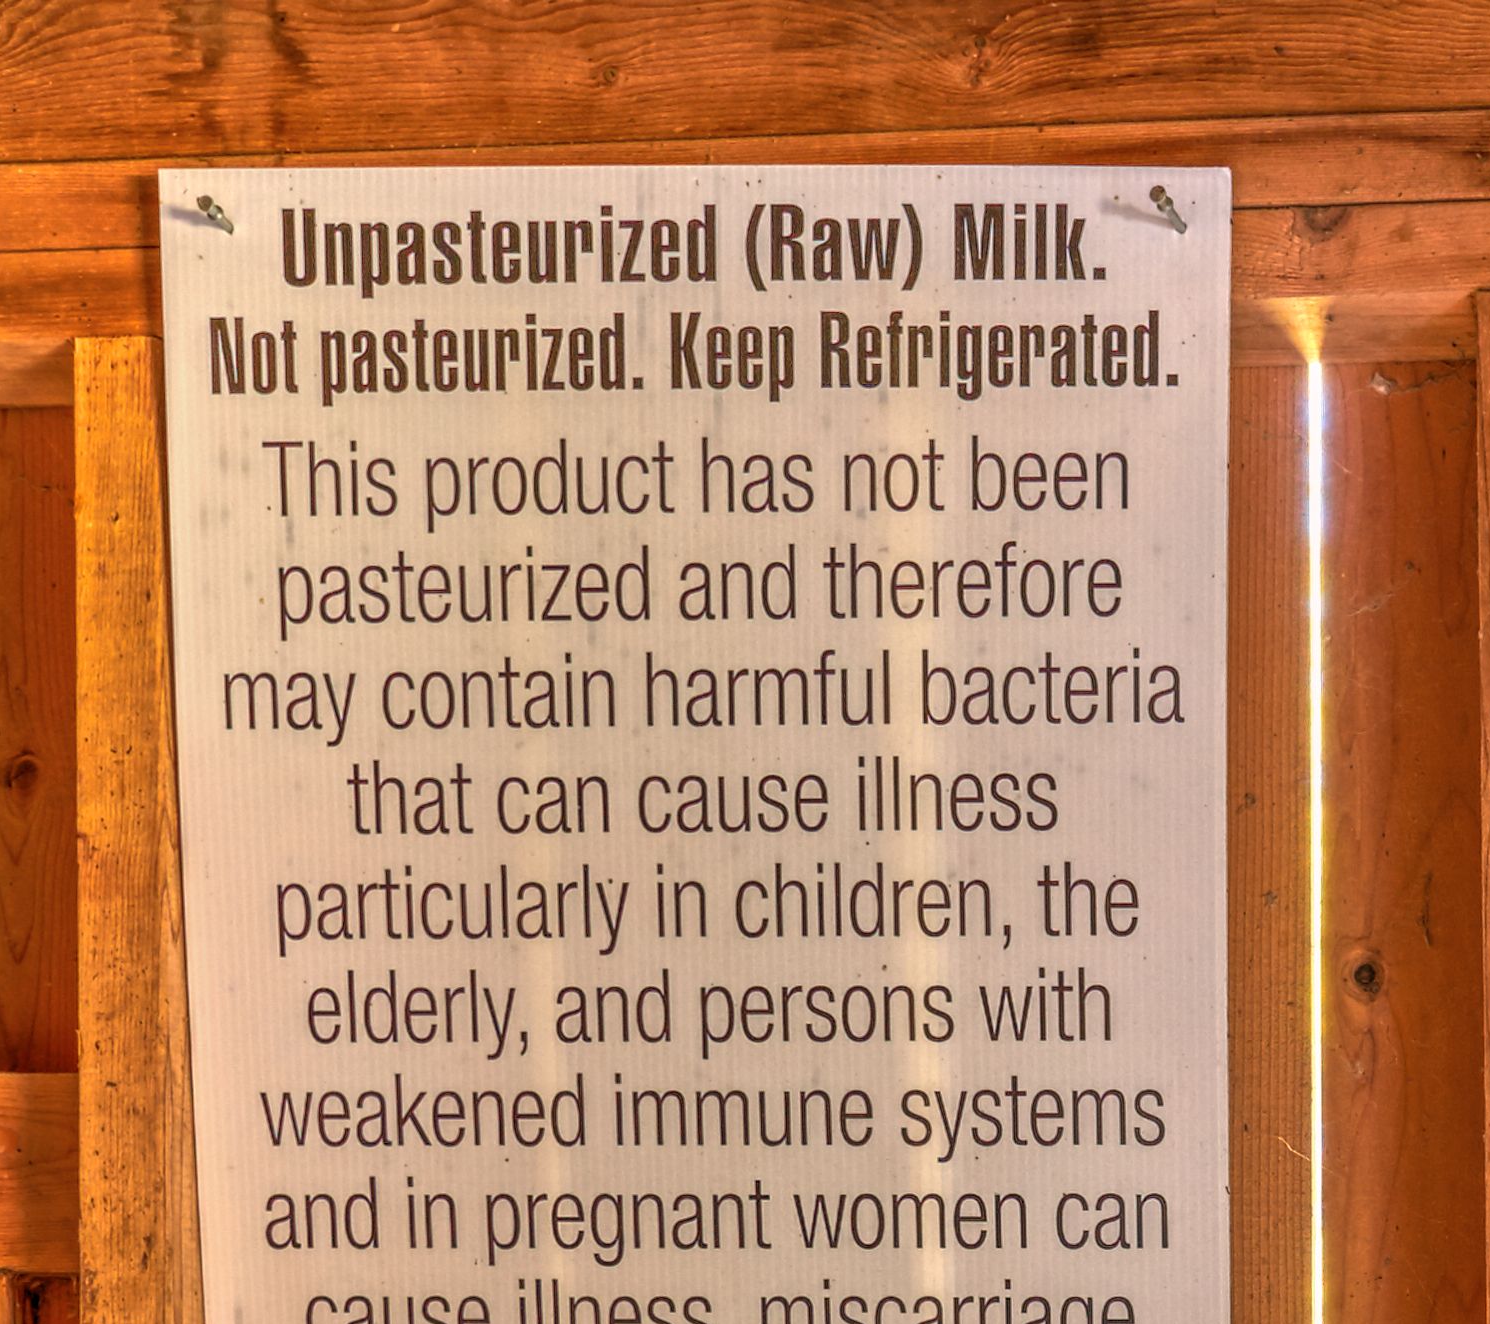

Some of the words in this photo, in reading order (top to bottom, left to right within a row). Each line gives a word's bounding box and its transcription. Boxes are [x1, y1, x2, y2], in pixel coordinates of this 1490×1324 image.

[281, 204, 718, 298] Unpasteurized
[746, 204, 924, 292] (Raw)
[952, 204, 1108, 282] Milk.
[209, 316, 301, 395] Not
[322, 312, 644, 406] pasteurized.
[671, 311, 796, 401] Keep
[821, 309, 1181, 400] Refrigerated.
[262, 440, 399, 517] This
[426, 438, 674, 530] product
[702, 438, 814, 513] has
[842, 440, 944, 513] not
[971, 438, 1129, 511] been
[279, 547, 651, 639] pasteurized
[679, 545, 797, 620] and
[823, 543, 1122, 618] therefore
[222, 667, 356, 745] may
[382, 656, 616, 731] contain
[644, 651, 892, 729] harmful
[922, 648, 1183, 725] bacteria
[347, 761, 473, 836] that
[497, 774, 609, 836] can
[637, 772, 829, 834] cause
[857, 757, 1060, 832] illness
[277, 866, 628, 958] particularly
[656, 866, 708, 939] in
[735, 862, 1012, 944] children,
[1038, 864, 1140, 937] the
[307, 971, 528, 1061] elderly,
[554, 971, 672, 1044] and
[701, 981, 954, 1059] persons
[982, 969, 1113, 1042] with
[260, 1076, 585, 1148] weakened
[613, 1074, 873, 1148] immune
[899, 1078, 1167, 1162] systems
[264, 1179, 380, 1252] and
[407, 1178, 460, 1251] in
[487, 1181, 768, 1268] pregnant
[796, 1195, 1029, 1251] women
[1055, 1192, 1169, 1251] can
